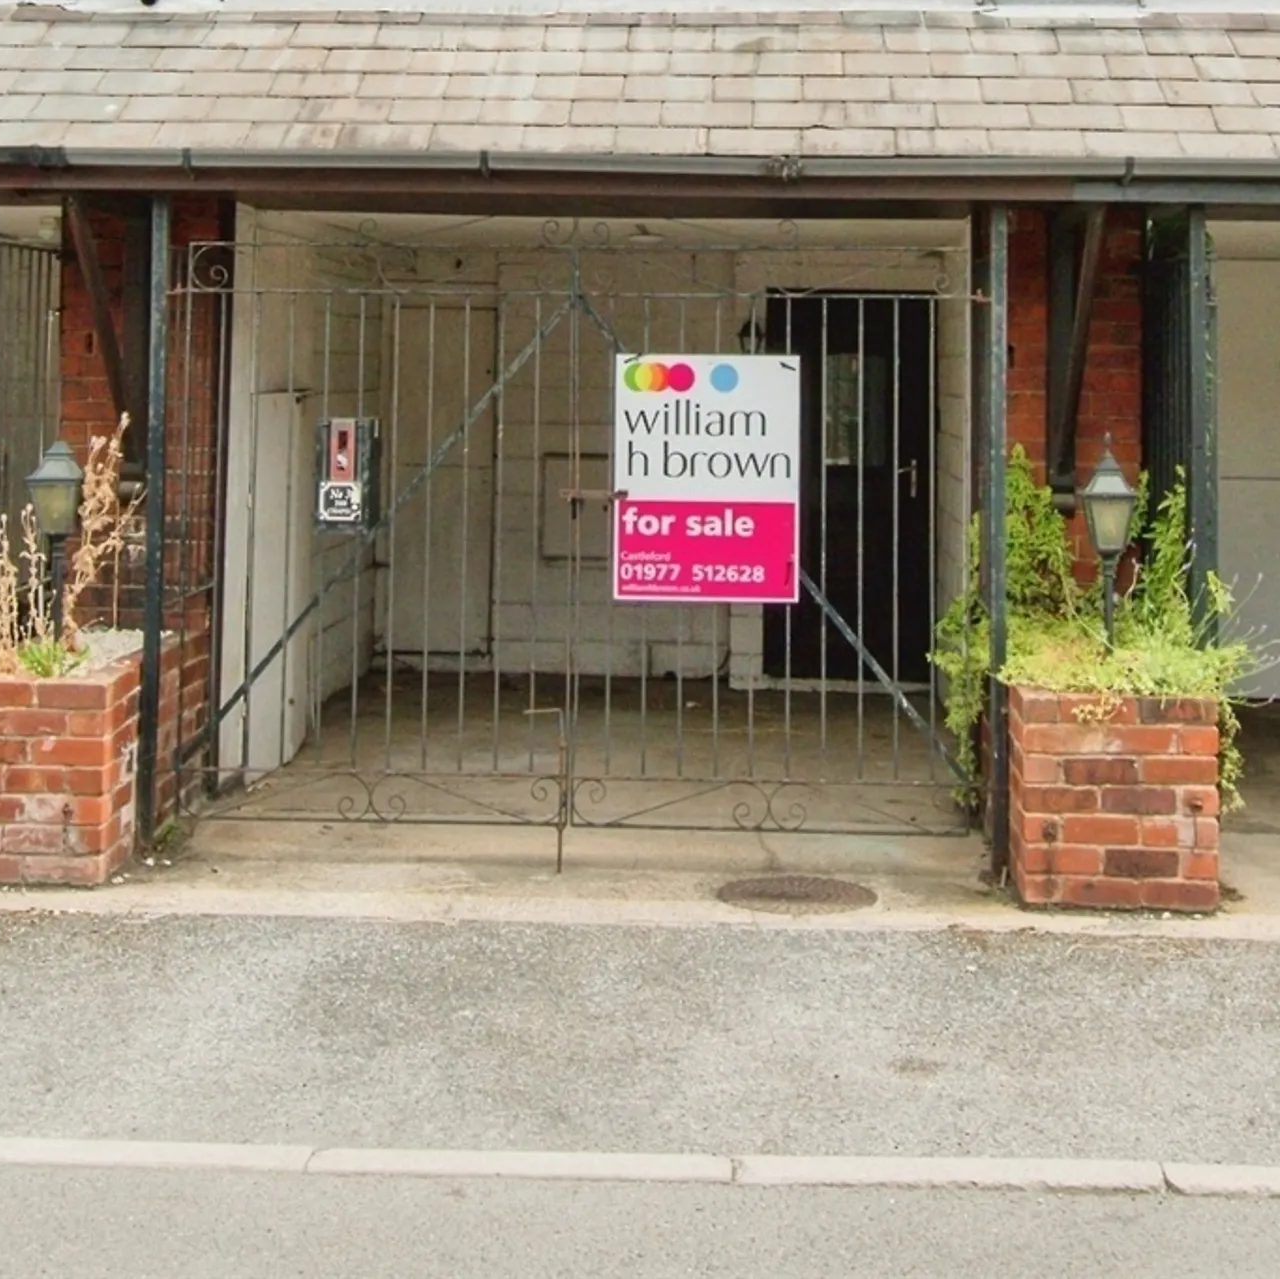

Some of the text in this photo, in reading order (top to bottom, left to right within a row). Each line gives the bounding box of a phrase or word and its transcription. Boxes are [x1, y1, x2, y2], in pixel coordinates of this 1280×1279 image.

[624, 399, 767, 437] william
[627, 440, 792, 479] h brown
[621, 506, 755, 538] for sale
[620, 563, 766, 583] 01977 512628
